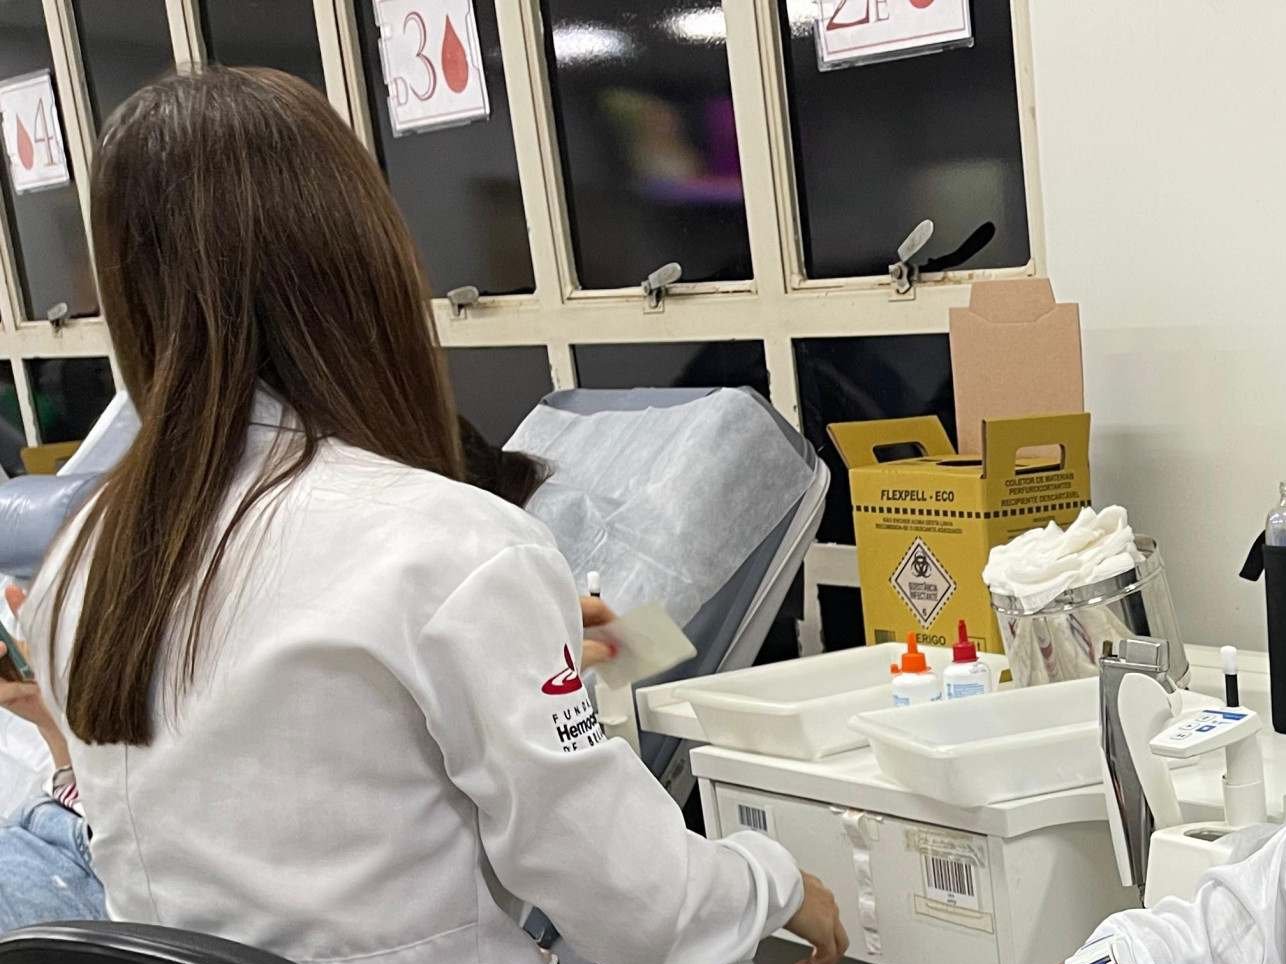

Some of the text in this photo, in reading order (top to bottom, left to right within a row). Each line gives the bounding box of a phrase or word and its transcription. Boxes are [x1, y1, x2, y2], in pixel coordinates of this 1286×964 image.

[881, 489, 927, 501] FLEXPELL
[935, 491, 955, 502] ECO
[916, 633, 946, 646] ERIGO
